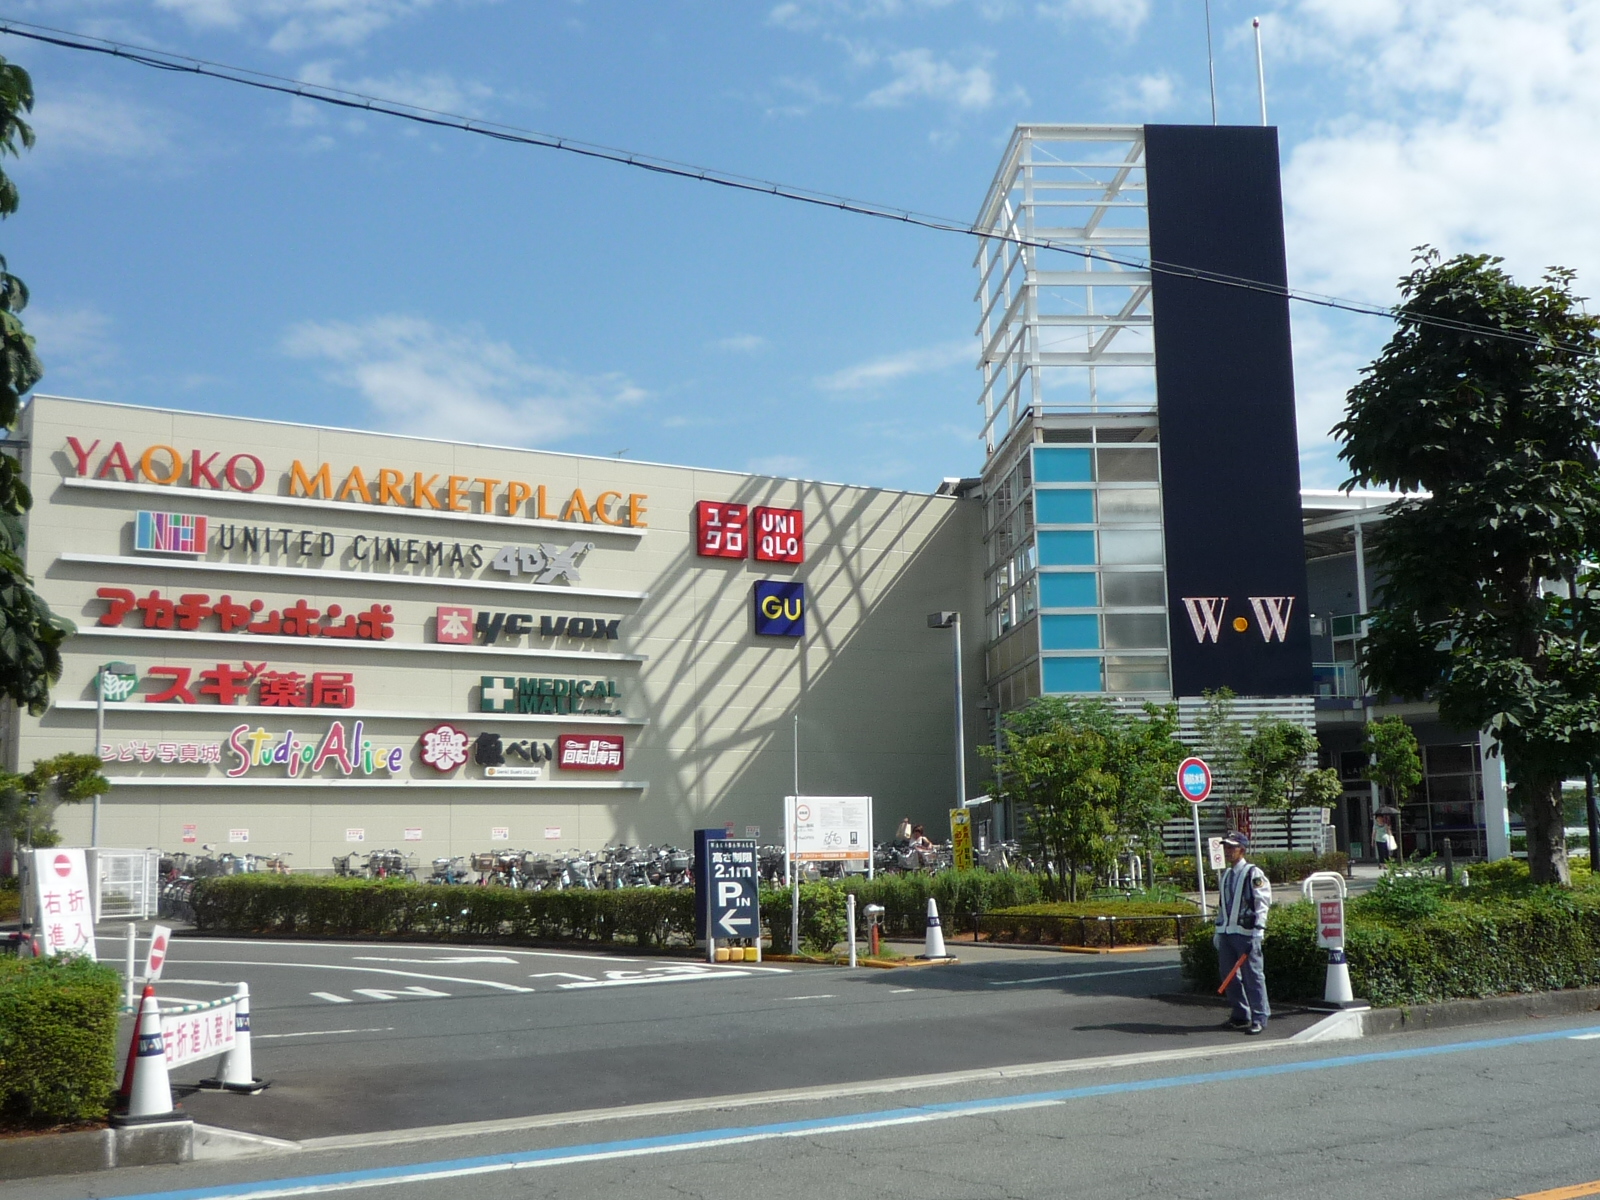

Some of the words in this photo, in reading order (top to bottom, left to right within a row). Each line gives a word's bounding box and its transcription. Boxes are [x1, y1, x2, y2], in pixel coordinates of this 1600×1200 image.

[67, 436, 265, 492] YAOKO
[290, 459, 649, 528] MARKETPLACE
[220, 524, 334, 557] UNITED
[353, 534, 483, 569] CINEMAS
[97, 587, 394, 640] アカチャンホンポ
[761, 595, 801, 621] GU
[441, 610, 469, 640] 本
[145, 661, 355, 709] スギ薬局
[518, 677, 622, 698] MEDICAL
[518, 696, 582, 714] MALL
[101, 742, 221, 764] こども写真城
[227, 723, 315, 778] Studio
[312, 720, 403, 776] Alice
[712, 851, 753, 863] 高さ制限
[714, 863, 752, 878] 2.1m
[43, 889, 85, 914] 右折
[48, 922, 88, 946] 進入
[161, 1010, 234, 1063] 右折進入禁止
